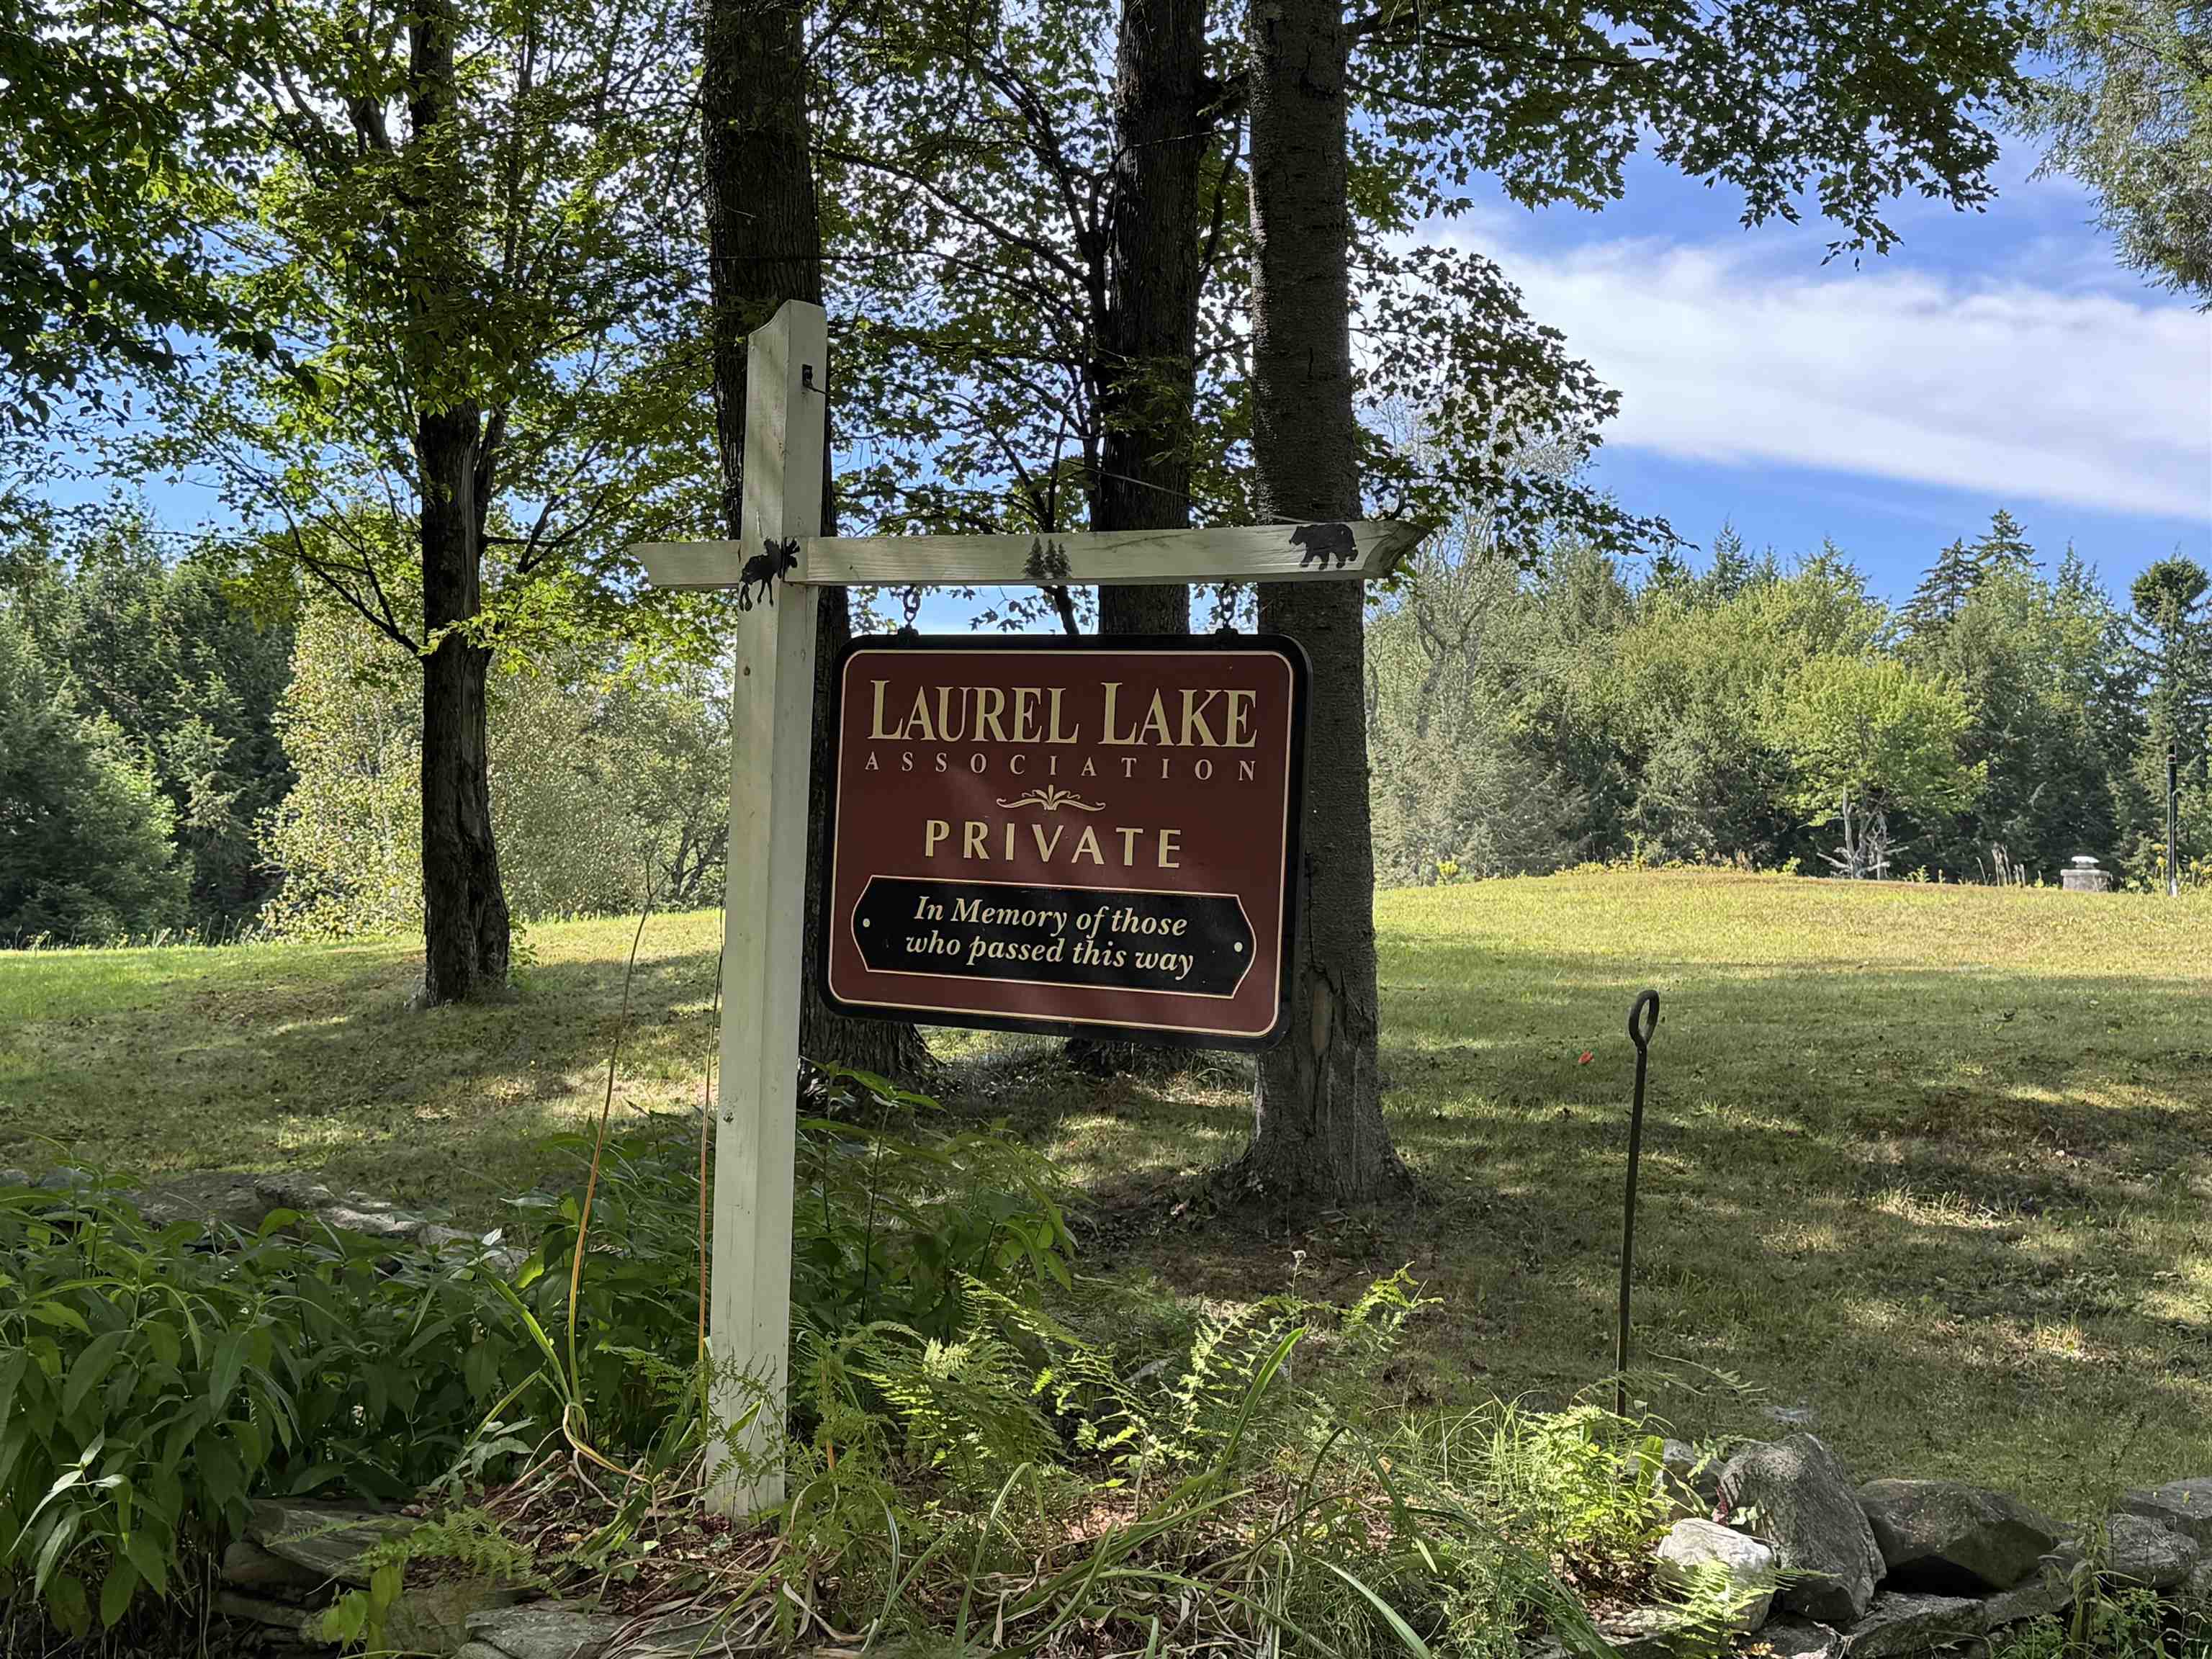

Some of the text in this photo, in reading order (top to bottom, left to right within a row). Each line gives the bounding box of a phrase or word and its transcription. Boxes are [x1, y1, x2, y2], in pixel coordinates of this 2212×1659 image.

[867, 680, 1258, 748] LAUREL LAKE
[864, 751, 1256, 781] ASSOCIATION
[925, 819, 1182, 869] PRIVATE
[913, 896, 1188, 938] In Memory of those
[906, 930, 1194, 980] who passed this way
